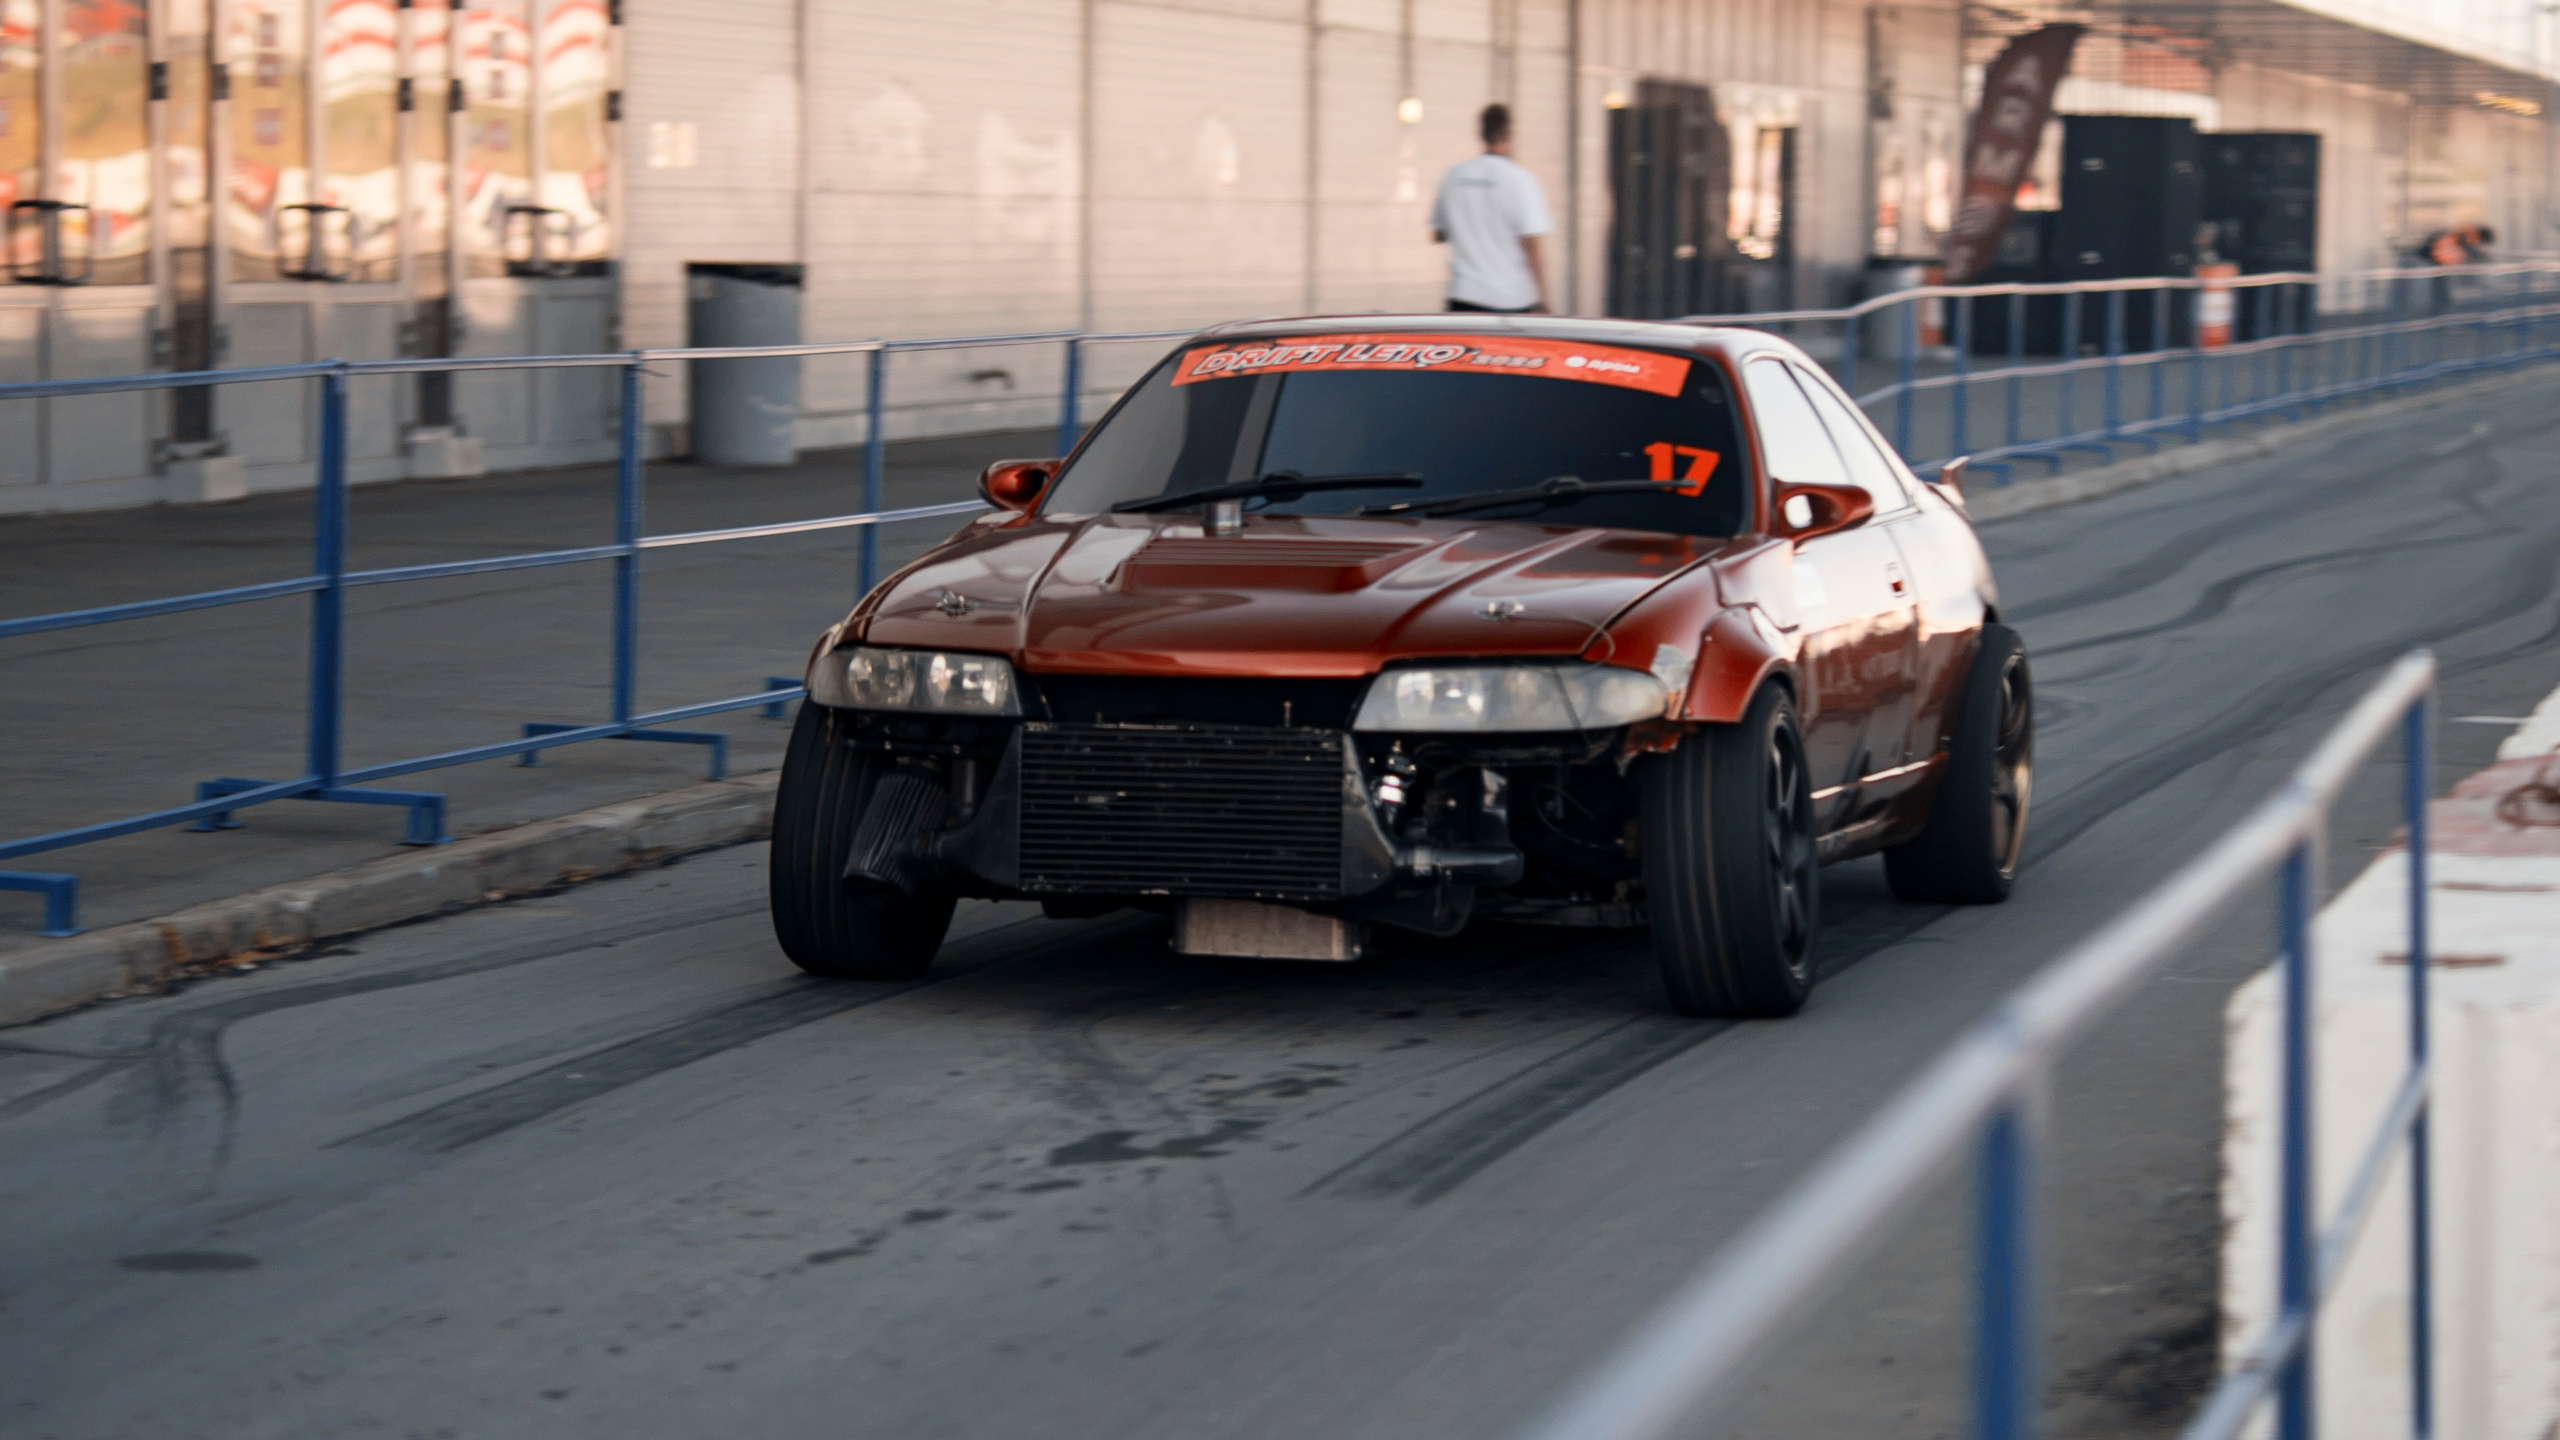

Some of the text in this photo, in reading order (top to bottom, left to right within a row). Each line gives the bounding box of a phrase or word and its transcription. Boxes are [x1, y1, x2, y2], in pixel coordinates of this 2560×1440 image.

[1191, 343, 1345, 375] DRIFT
[1335, 342, 1467, 365] LETO
[1643, 441, 1720, 497] 17
